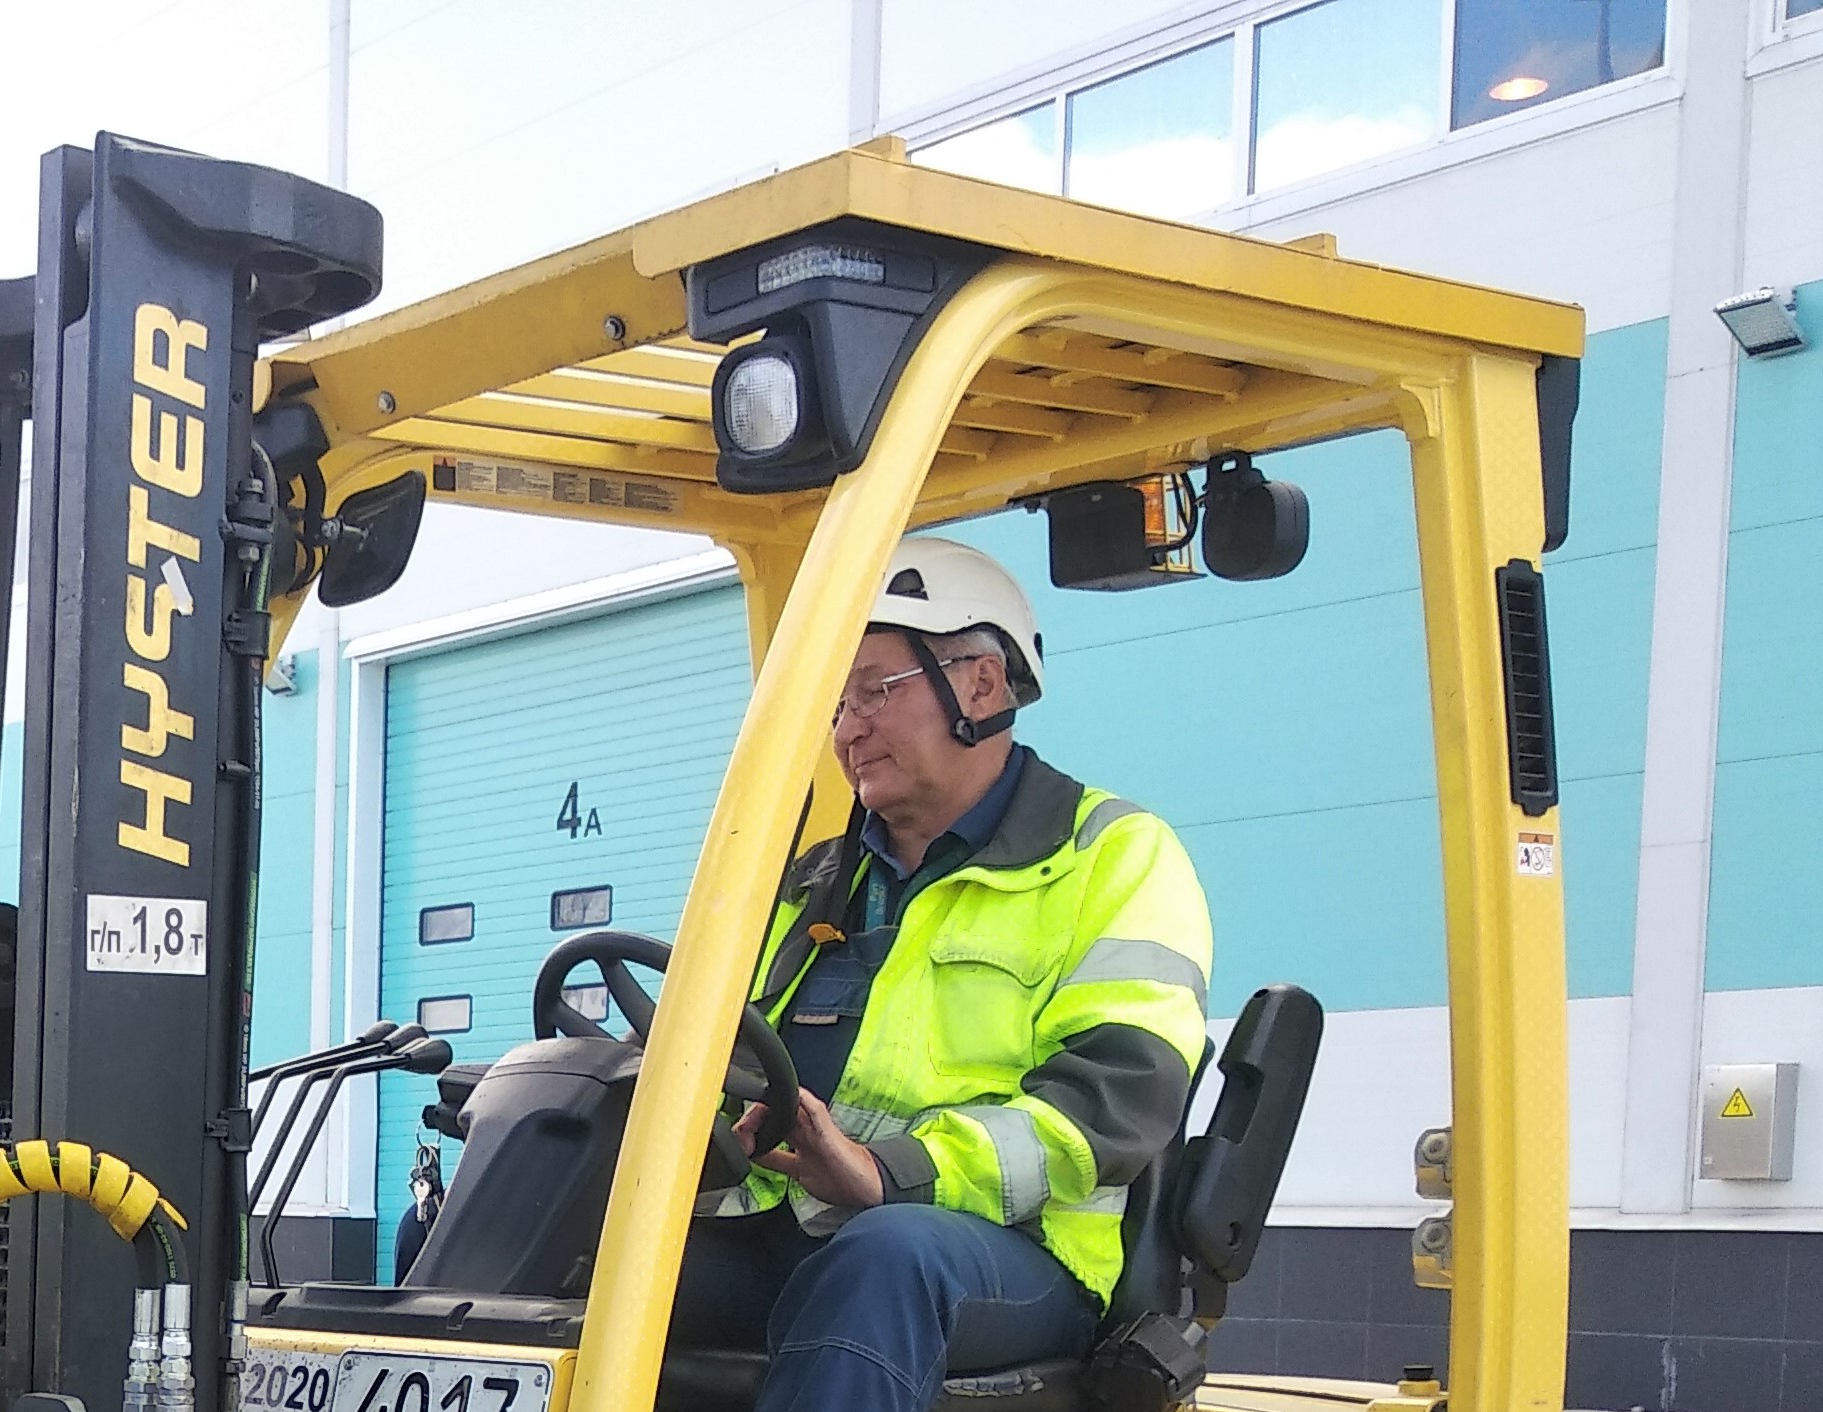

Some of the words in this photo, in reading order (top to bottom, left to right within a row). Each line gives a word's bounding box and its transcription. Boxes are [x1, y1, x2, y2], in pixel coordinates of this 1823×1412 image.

[118, 302, 209, 867] HYSTER
[133, 906, 184, 965] 1,8
[245, 1362, 328, 1412] 2020
